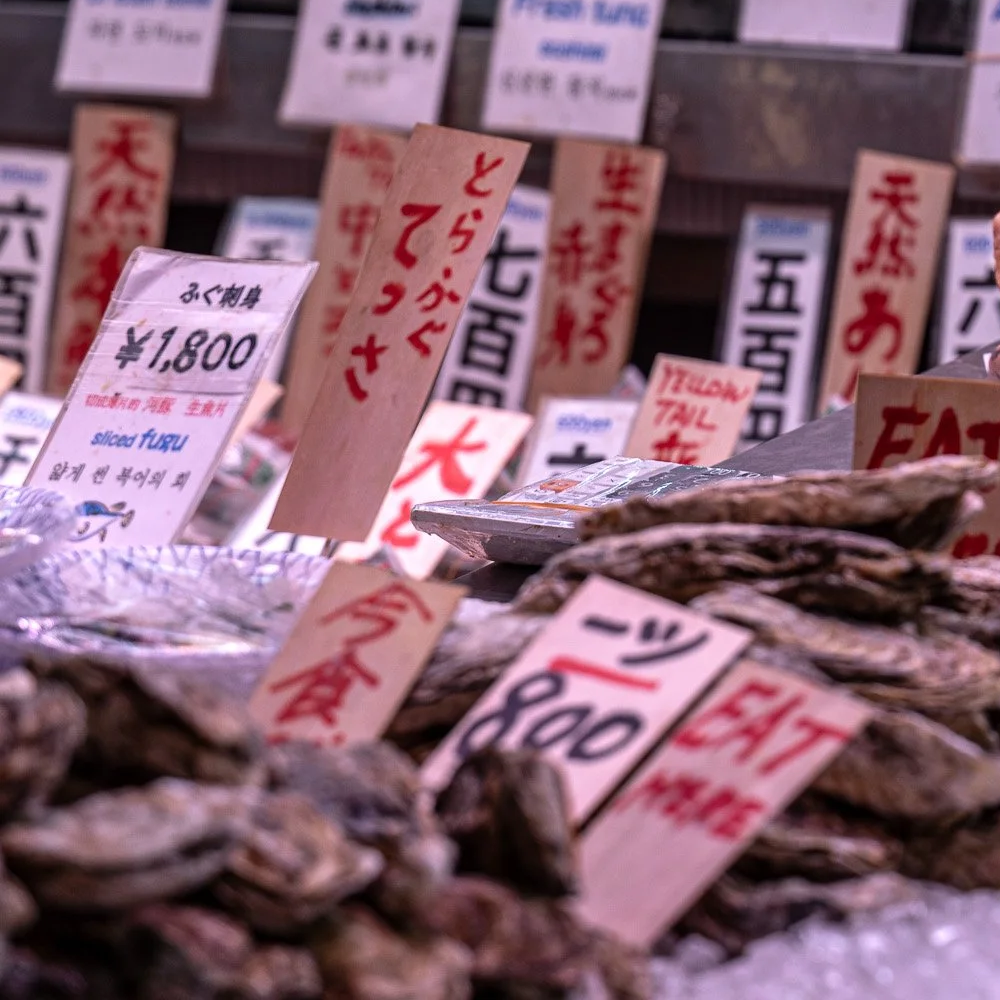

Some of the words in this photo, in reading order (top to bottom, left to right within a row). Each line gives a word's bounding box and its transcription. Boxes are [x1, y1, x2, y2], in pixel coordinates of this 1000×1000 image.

[180, 282, 264, 310] ふぐ刺身
[114, 325, 259, 375] ¥1,800
[656, 363, 751, 404] YELLOW
[653, 398, 718, 432] TAIL
[90, 430, 138, 449] sliced
[138, 427, 190, 454] fugu
[455, 669, 646, 763] 800
[672, 677, 853, 777] EAT
